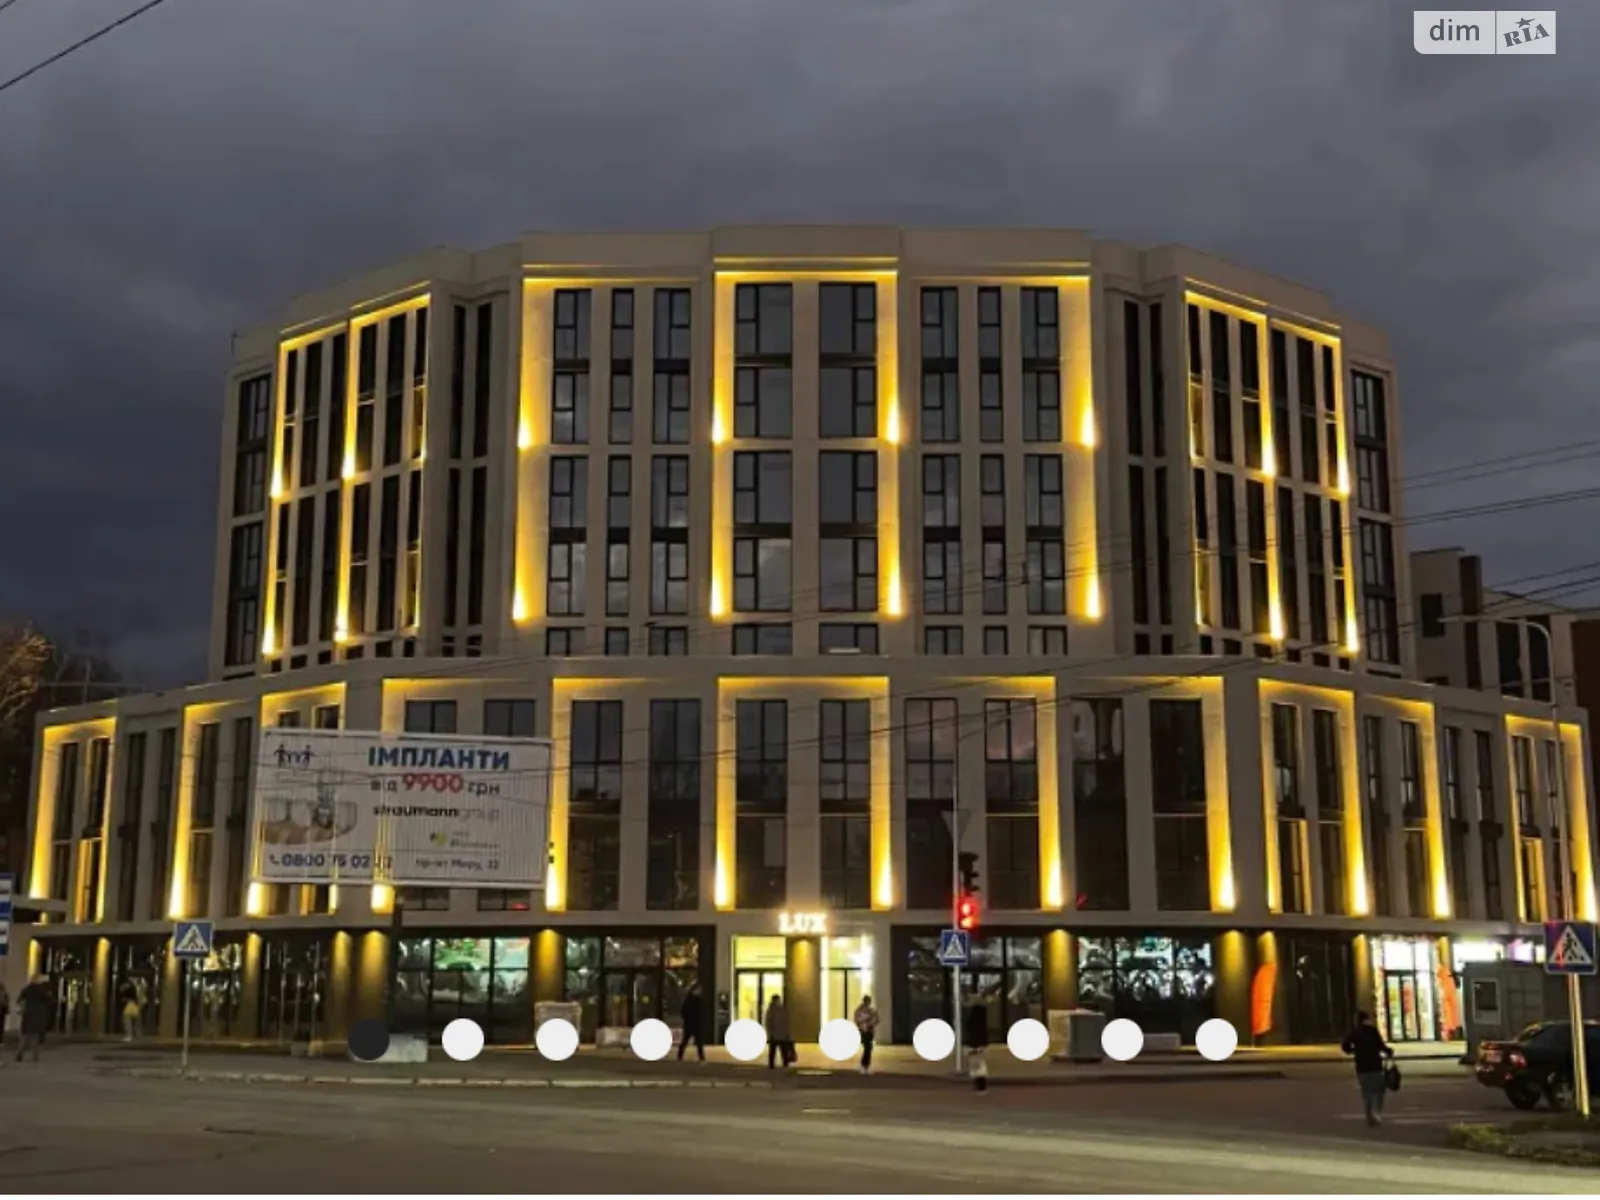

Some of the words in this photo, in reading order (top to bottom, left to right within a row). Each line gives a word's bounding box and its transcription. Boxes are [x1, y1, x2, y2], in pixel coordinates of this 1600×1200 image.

[368, 746, 510, 770] ІМПЛАНТИ
[402, 773, 464, 793] 9900
[468, 780, 500, 797] грн
[281, 853, 325, 867] 0800
[351, 854, 371, 869] 02
[778, 911, 827, 934] LUX
